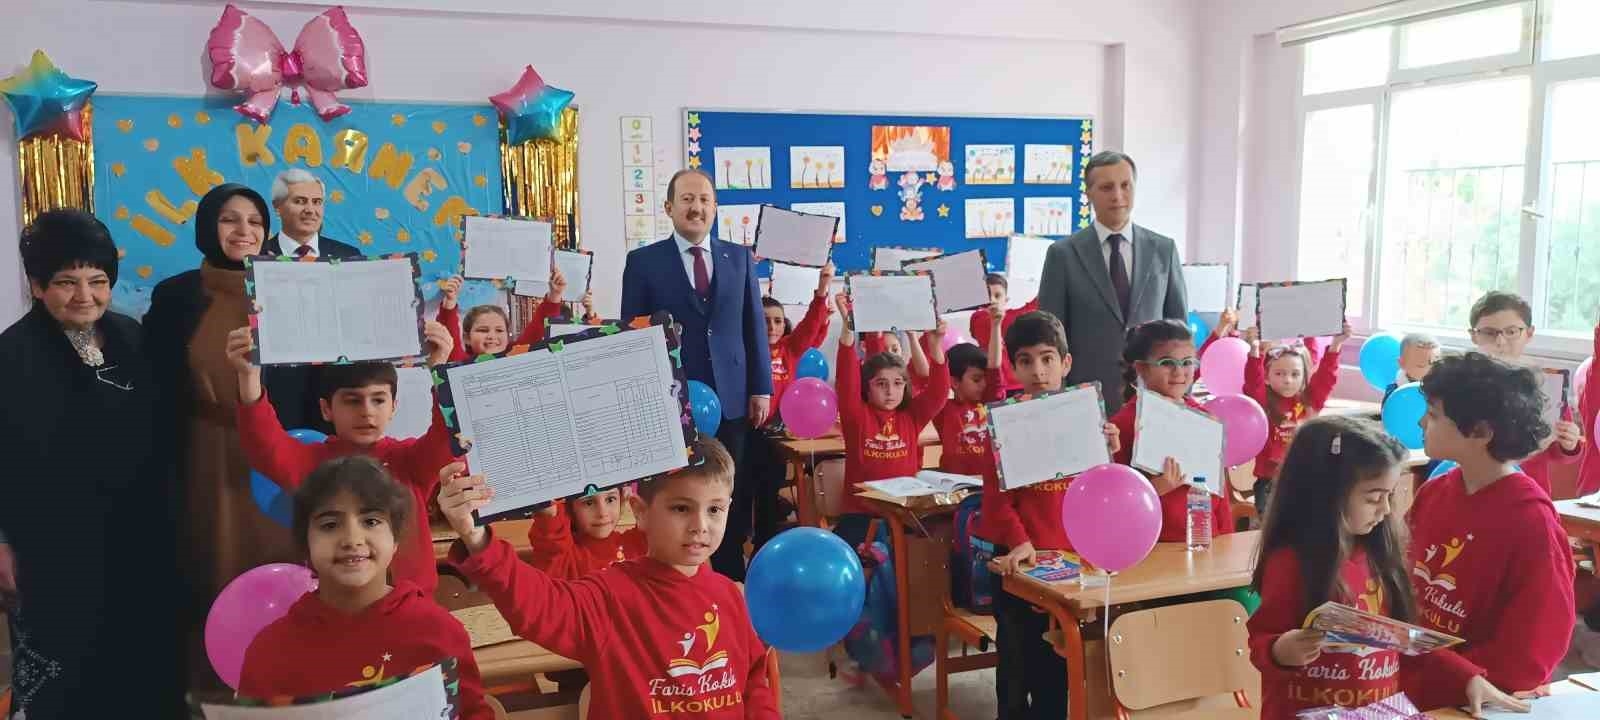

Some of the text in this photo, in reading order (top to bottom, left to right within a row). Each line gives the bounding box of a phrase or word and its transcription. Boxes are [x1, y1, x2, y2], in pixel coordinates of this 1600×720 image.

[634, 168, 643, 180] 2
[635, 192, 645, 204] 3
[1303, 663, 1351, 680] aris
[648, 677, 697, 697] Faris
[651, 691, 743, 714] İLKOKULU
